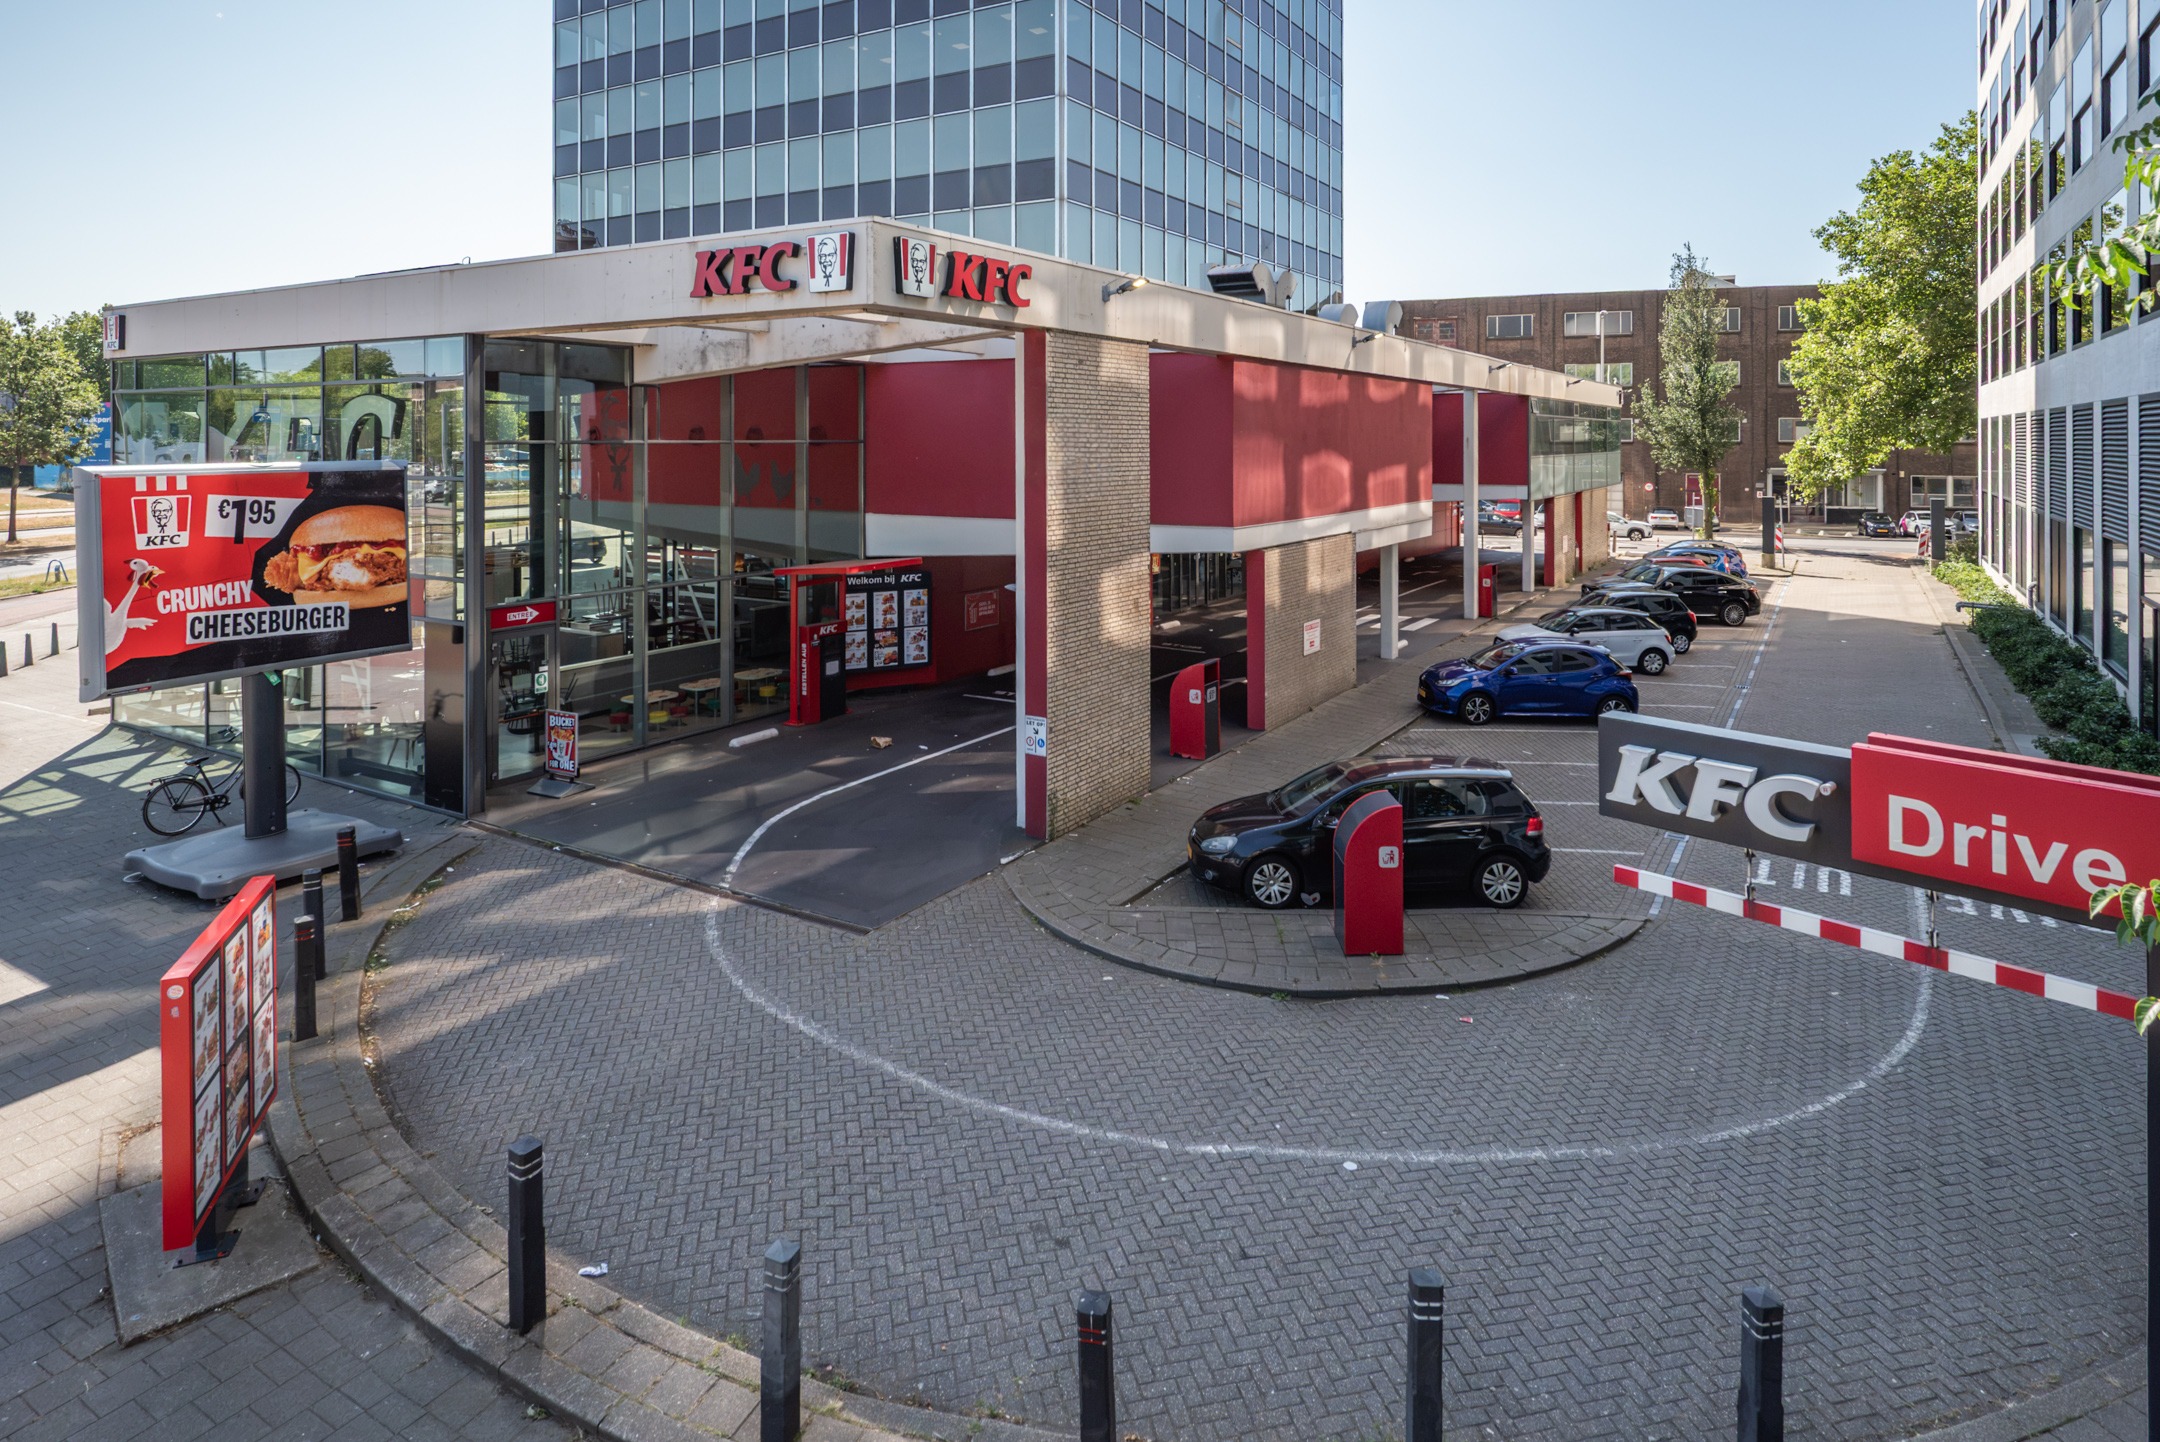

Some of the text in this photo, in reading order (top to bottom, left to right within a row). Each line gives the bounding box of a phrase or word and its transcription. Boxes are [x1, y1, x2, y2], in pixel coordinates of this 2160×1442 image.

[689, 241, 799, 298] KFC
[944, 251, 1032, 307] KFC
[107, 341, 117, 349] KFC
[145, 534, 181, 547] KFC
[847, 573, 922, 585] Welkom bij KFC
[157, 579, 253, 614] CRUNCHY
[189, 605, 346, 639] CHEESEBURGER
[819, 624, 838, 635] KFC
[549, 715, 575, 727] BUCKET
[549, 760, 575, 771] FOR ONE
[1605, 744, 1823, 842] KFC
[1888, 794, 2127, 895] Drive
